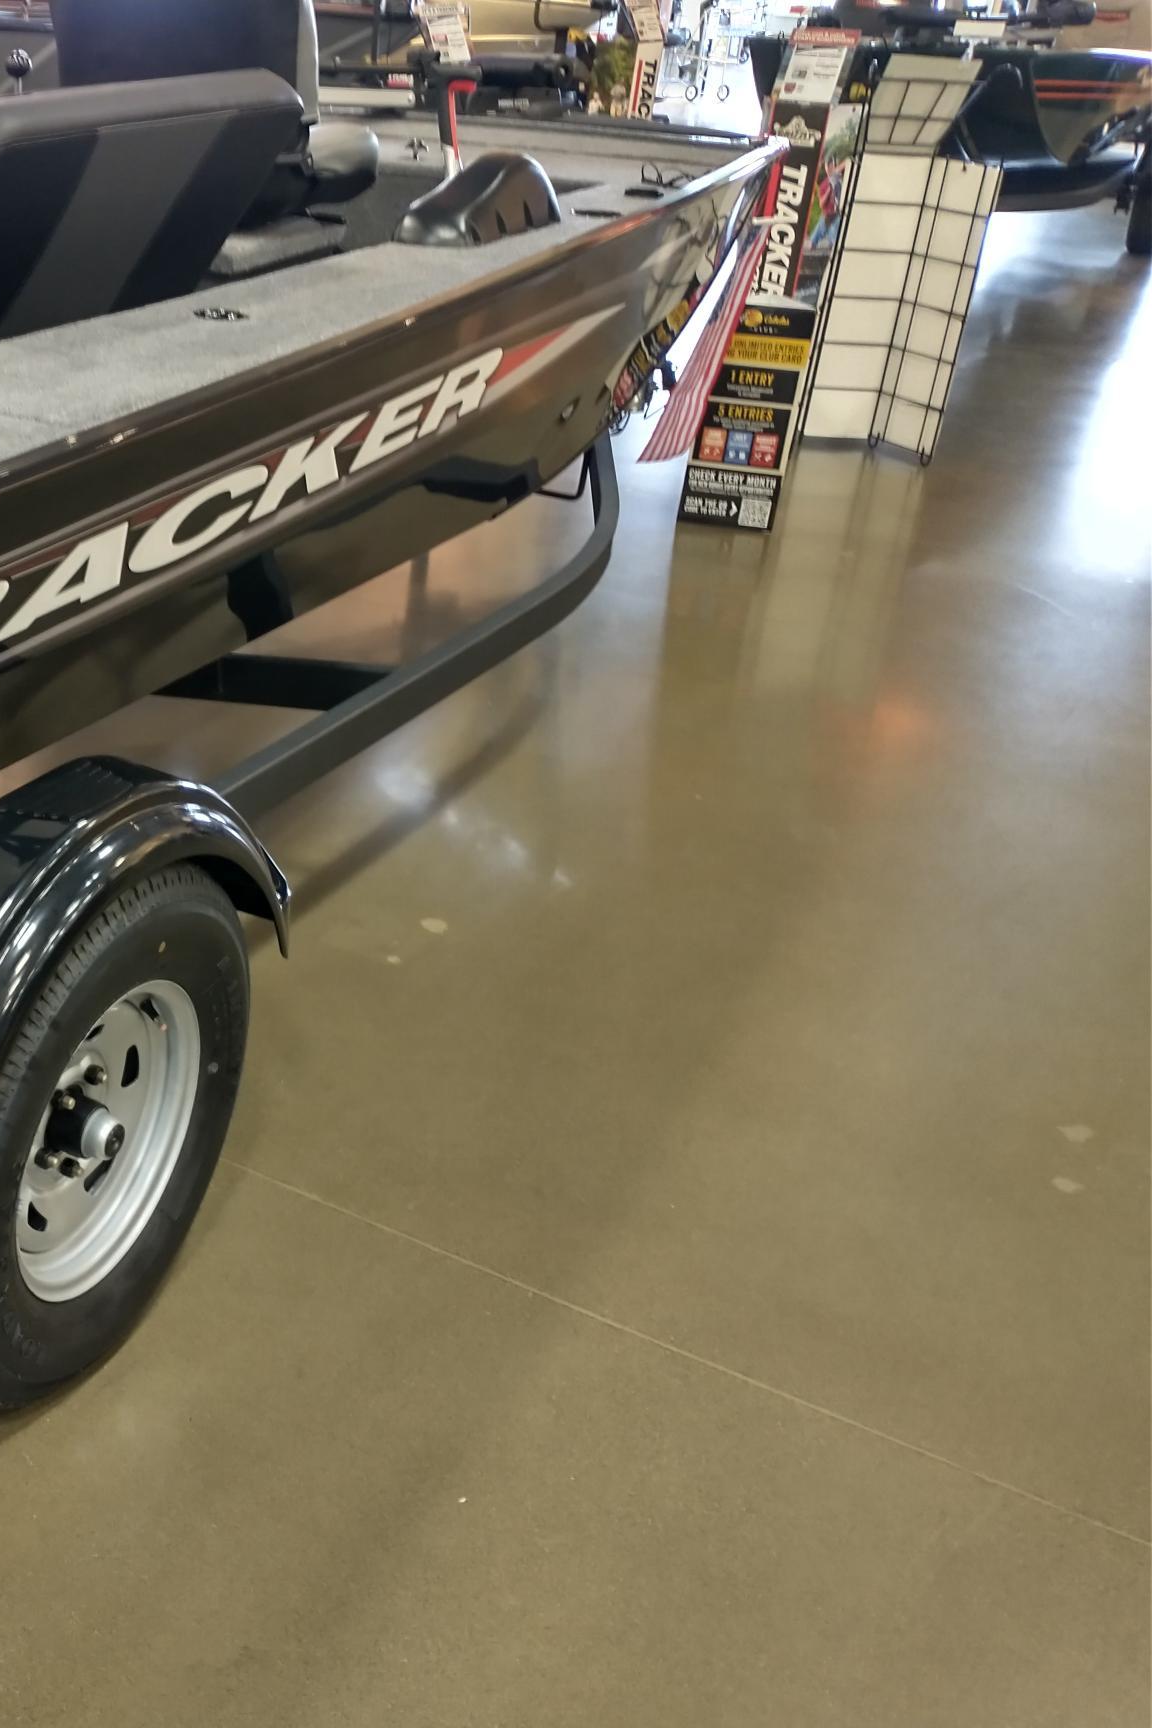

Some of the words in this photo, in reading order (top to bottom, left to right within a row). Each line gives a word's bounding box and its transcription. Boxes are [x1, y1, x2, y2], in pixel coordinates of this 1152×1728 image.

[775, 343, 804, 353] ENTRIES
[738, 350, 757, 359] YOUR
[760, 352, 778, 362] CLUB
[781, 354, 802, 365] CARD
[732, 370, 736, 383] 1
[738, 370, 774, 387] ENTRY
[728, 404, 774, 422] ENTRIES
[689, 467, 716, 481] CHECK
[718, 471, 744, 487] EVERY
[746, 474, 777, 489] MONTH
